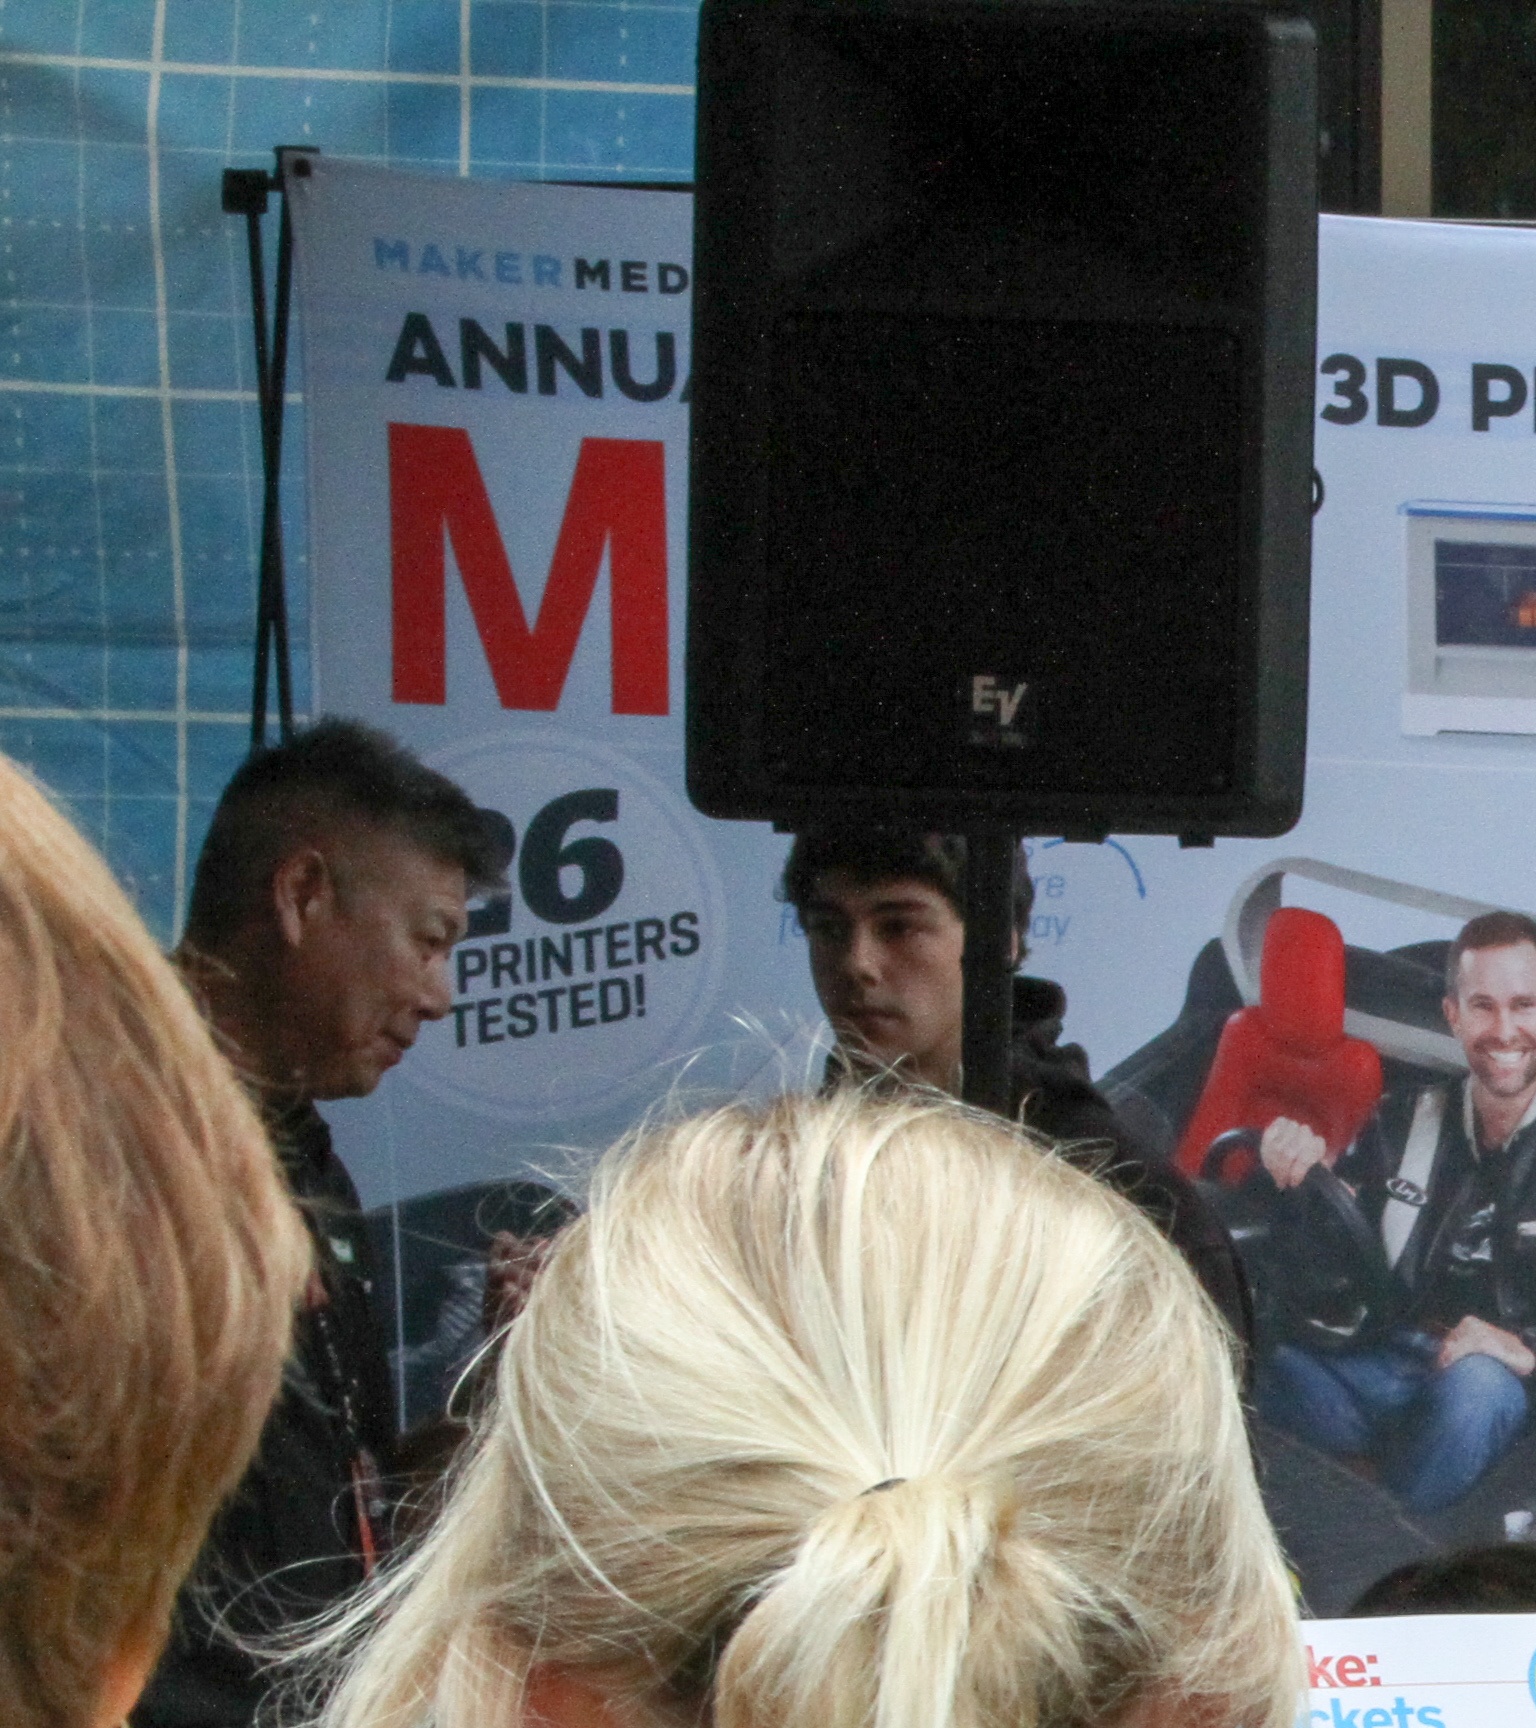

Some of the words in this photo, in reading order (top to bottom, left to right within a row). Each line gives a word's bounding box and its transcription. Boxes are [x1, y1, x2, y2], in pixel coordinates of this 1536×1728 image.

[385, 312, 692, 403] ANNU
[1320, 354, 1440, 428] 3D
[456, 910, 700, 995] PRINTERS
[450, 975, 648, 1048] TESTED!
[1304, 1645, 1382, 1688] ke:
